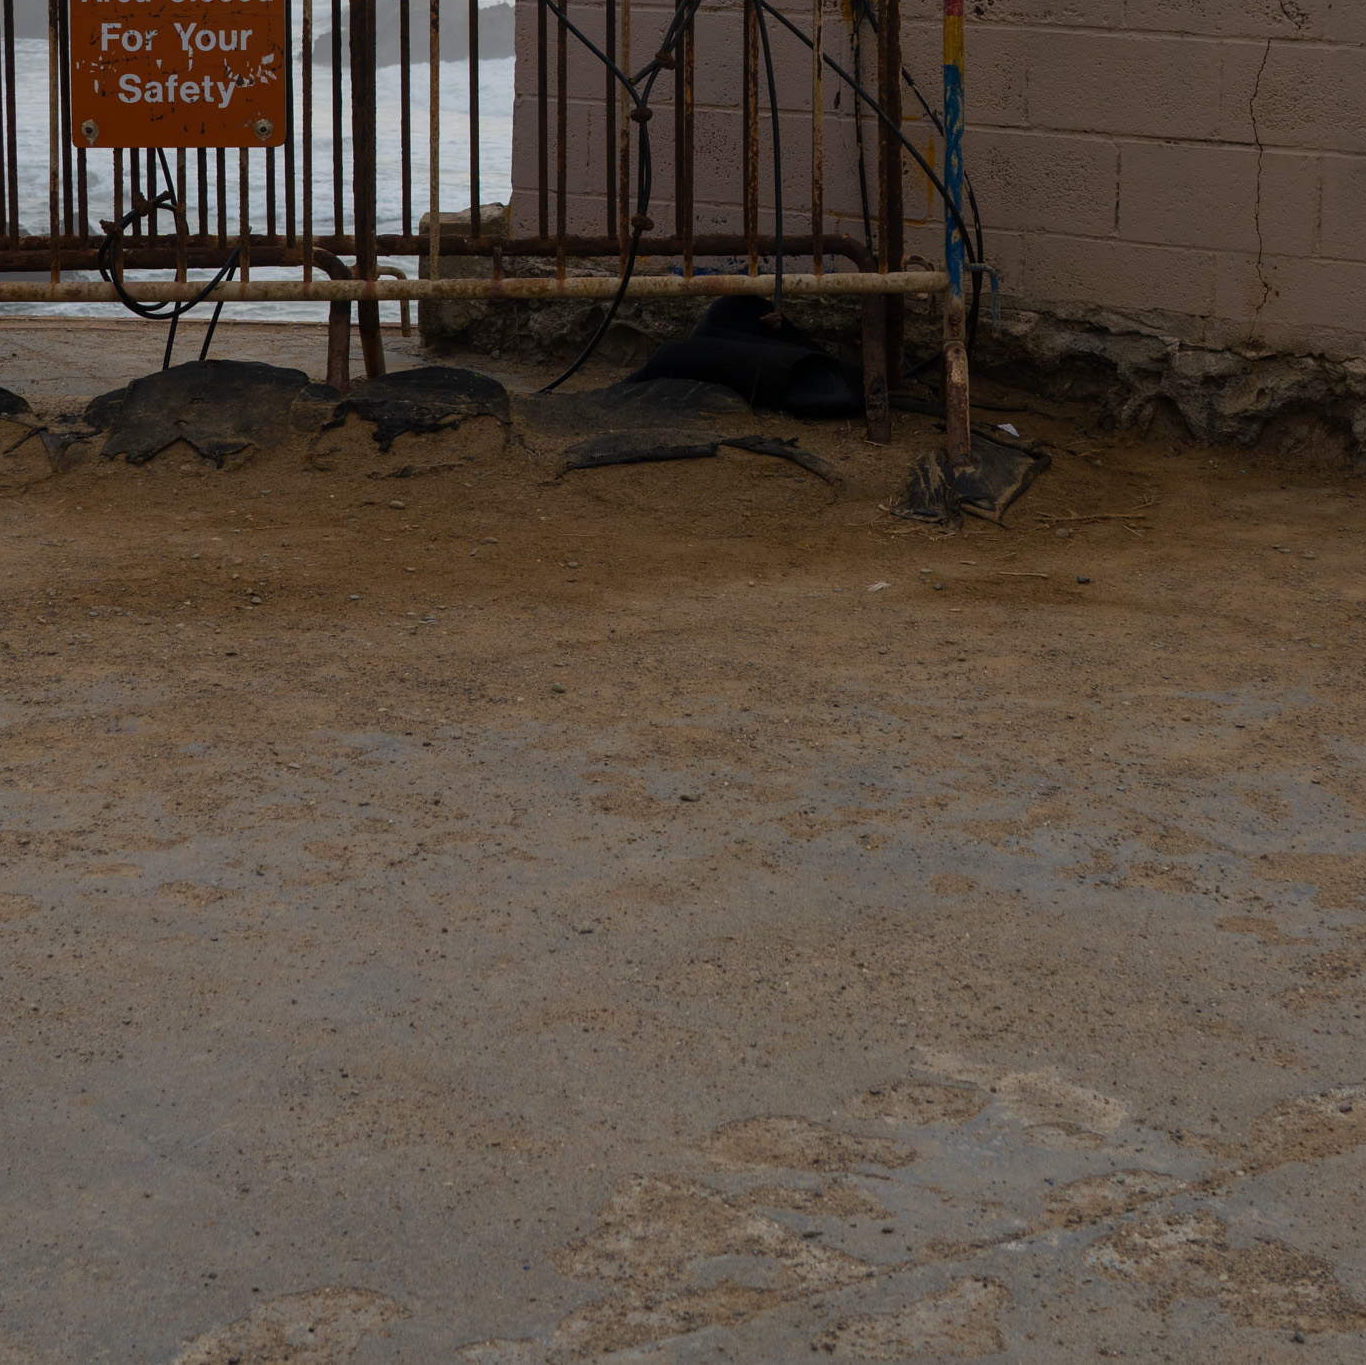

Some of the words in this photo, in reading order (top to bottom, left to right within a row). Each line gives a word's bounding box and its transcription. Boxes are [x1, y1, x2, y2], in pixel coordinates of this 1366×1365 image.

[101, 22, 158, 52] For
[173, 22, 253, 52] Your
[118, 73, 236, 109] Safety
